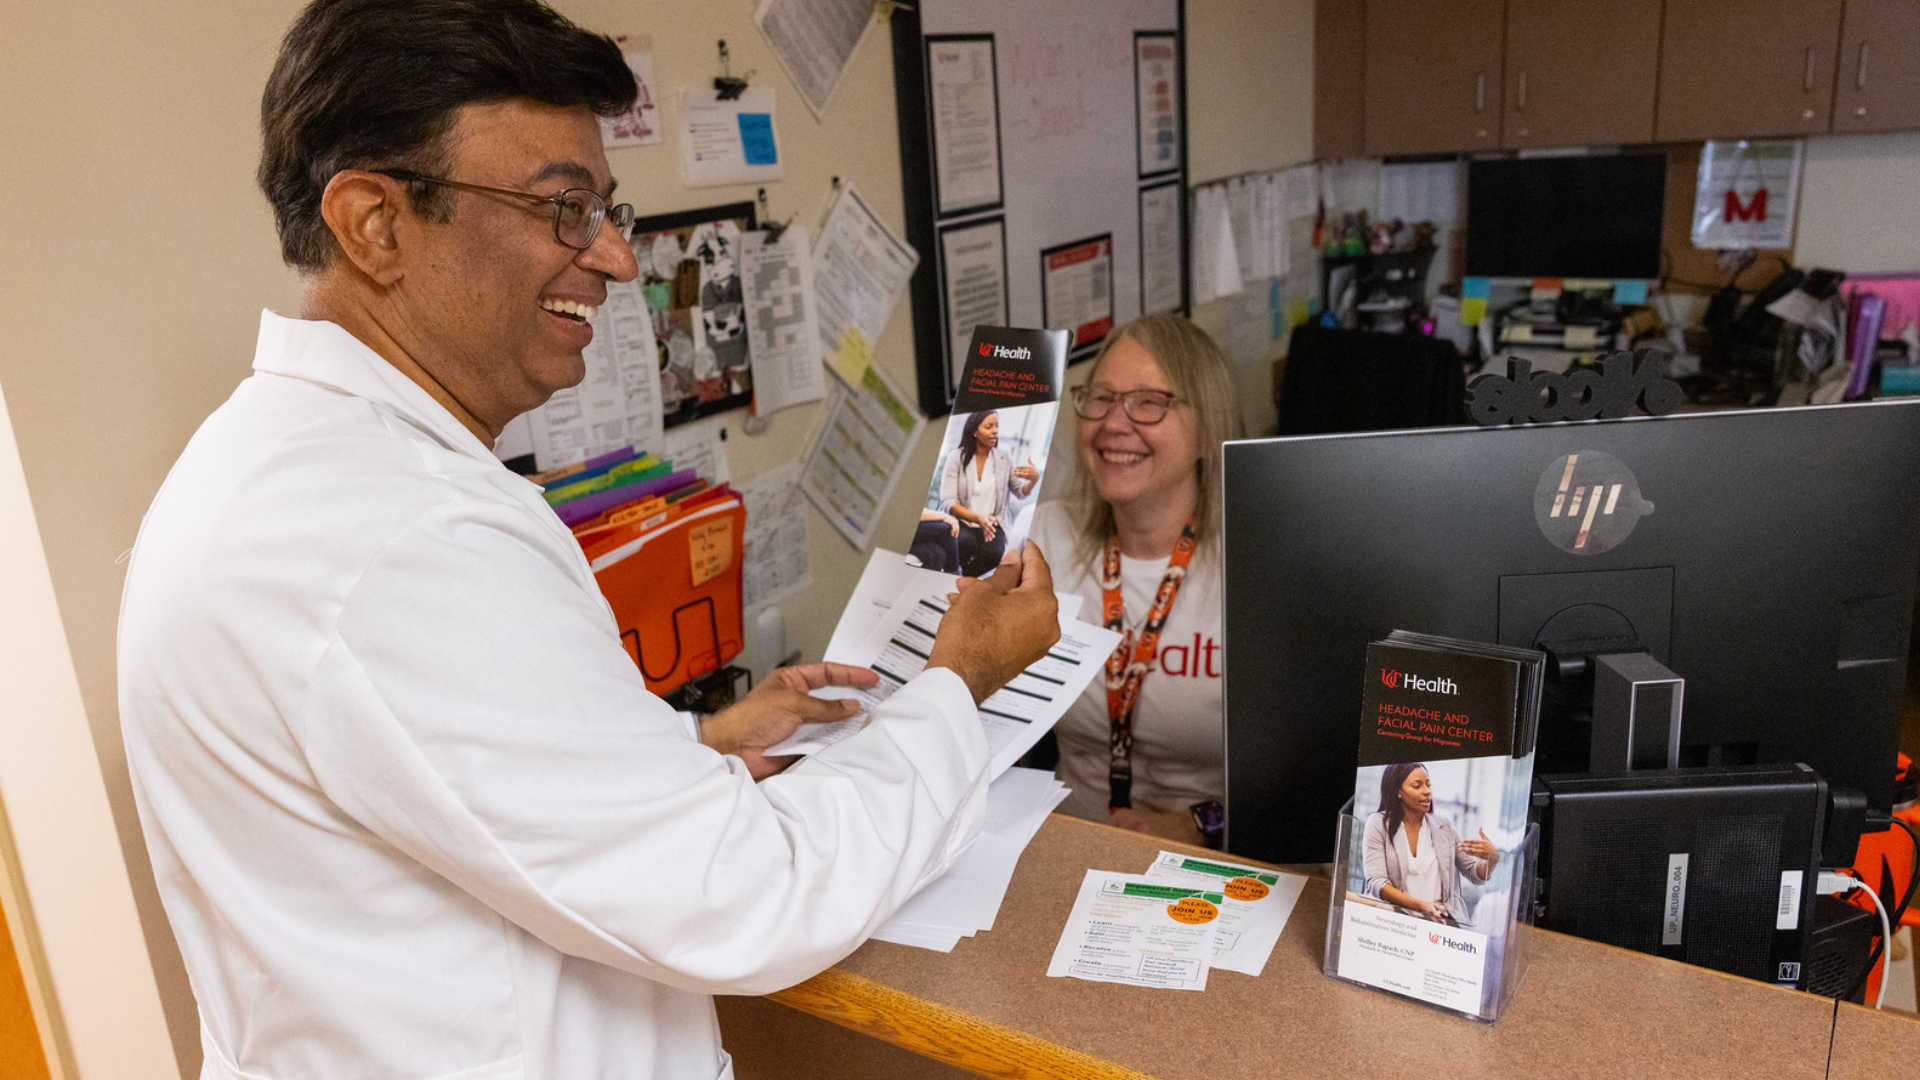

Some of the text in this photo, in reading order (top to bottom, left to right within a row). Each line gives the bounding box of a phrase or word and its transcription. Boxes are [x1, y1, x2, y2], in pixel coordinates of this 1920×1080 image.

[1724, 188, 1768, 224] M
[993, 345, 1031, 360] Health
[973, 368, 1035, 381] HEADACHE AND
[971, 377, 1050, 393] FACIAL PAIN CENTER
[1550, 454, 1622, 548] hp
[1403, 673, 1458, 695] Health
[1379, 703, 1470, 725] HEADACHE AND
[1377, 728, 1404, 740] Centering
[1405, 732, 1423, 743] Group
[1378, 716, 1494, 742] FACIAL PAIN CENTER
[1226, 884, 1247, 892] JOIN
[1182, 900, 1209, 908] PLEASE
[1669, 866, 1682, 934] UP_NEURO_004
[1442, 936, 1477, 955] Health
